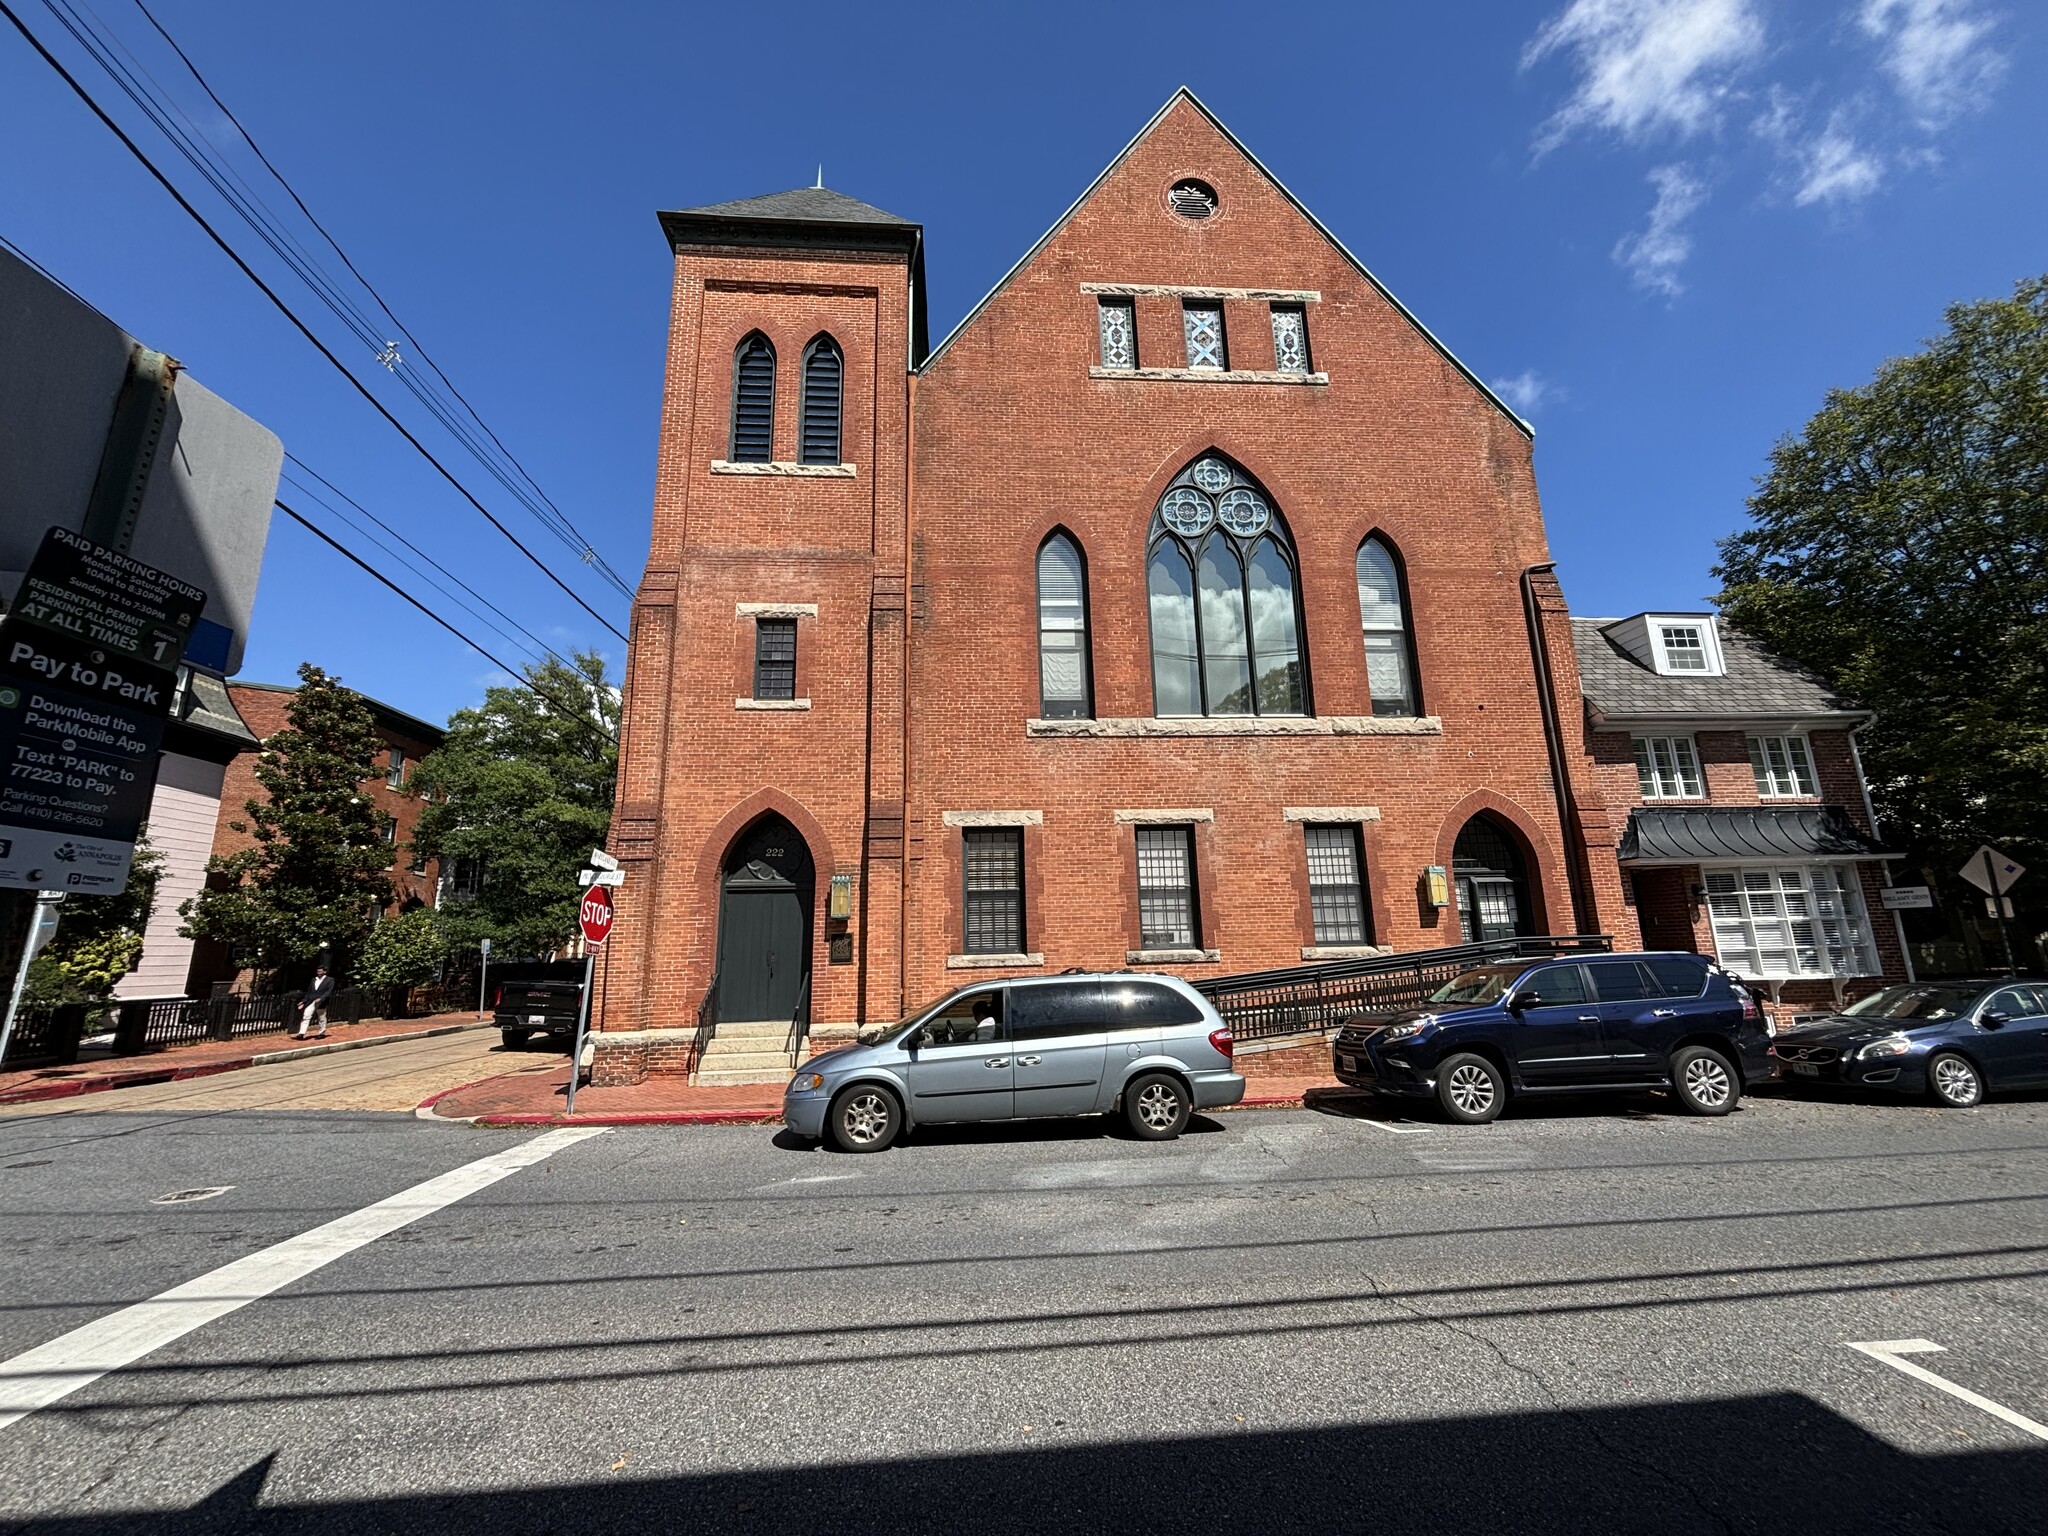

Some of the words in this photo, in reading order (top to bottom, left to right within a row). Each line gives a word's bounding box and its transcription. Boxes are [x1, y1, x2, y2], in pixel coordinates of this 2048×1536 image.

[53, 529, 91, 551] PAID
[94, 547, 156, 580] PARKING
[158, 574, 203, 601] HOURS
[81, 555, 122, 578] Monday
[130, 576, 172, 598] Saturday
[28, 578, 103, 612] RESIDENTIAL
[105, 607, 146, 628] PERMIT
[69, 576, 108, 598] Sunday
[110, 592, 119, 602] 12
[121, 596, 132, 606] to
[134, 602, 166, 620] 7:30PM
[86, 568, 114, 585] 10AM
[116, 579, 126, 589] to
[128, 584, 163, 604] 8:30PM
[20, 602, 50, 620] AT
[50, 614, 84, 633] ALL
[90, 624, 139, 651] TIMES
[29, 592, 83, 616] PARKING
[86, 610, 138, 636] ALLOWED
[152, 630, 177, 644] District
[153, 642, 167, 662] 1
[9, 642, 67, 679] Pay
[71, 662, 98, 686] to
[102, 671, 160, 706] Park
[25, 712, 114, 744] ParkMobile
[116, 736, 146, 753] App
[30, 696, 110, 727] Download
[113, 718, 136, 734] the
[10, 764, 62, 784] 77223
[66, 774, 82, 788] to
[85, 778, 117, 796] Pay.
[16, 746, 55, 765] Text
[120, 769, 134, 782] to
[0, 802, 22, 814] Call
[24, 806, 51, 818] (410)
[54, 811, 104, 827] 216-5620
[3, 788, 46, 806] Parking
[50, 796, 109, 814] Questions?
[78, 851, 122, 861] ANNAPOLIS
[765, 848, 784, 857] 222
[583, 900, 612, 926] STOP
